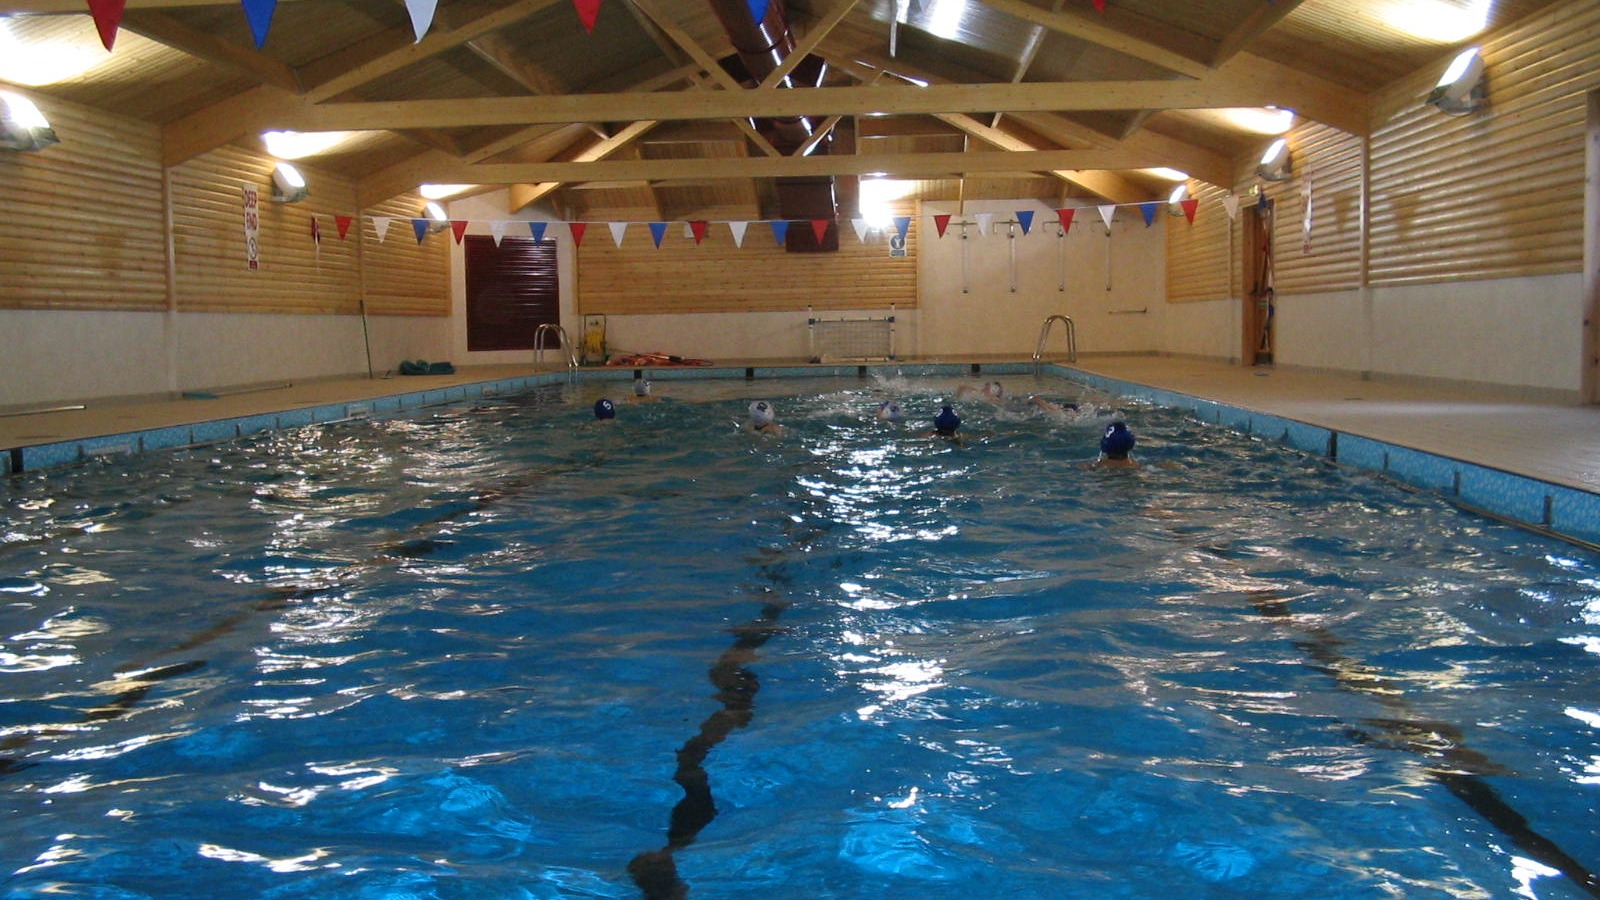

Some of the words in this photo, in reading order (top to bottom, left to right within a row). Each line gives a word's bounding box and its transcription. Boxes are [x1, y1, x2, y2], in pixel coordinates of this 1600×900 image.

[244, 189, 257, 208] DEEP
[246, 211, 257, 230] END
[602, 400, 612, 410] 5
